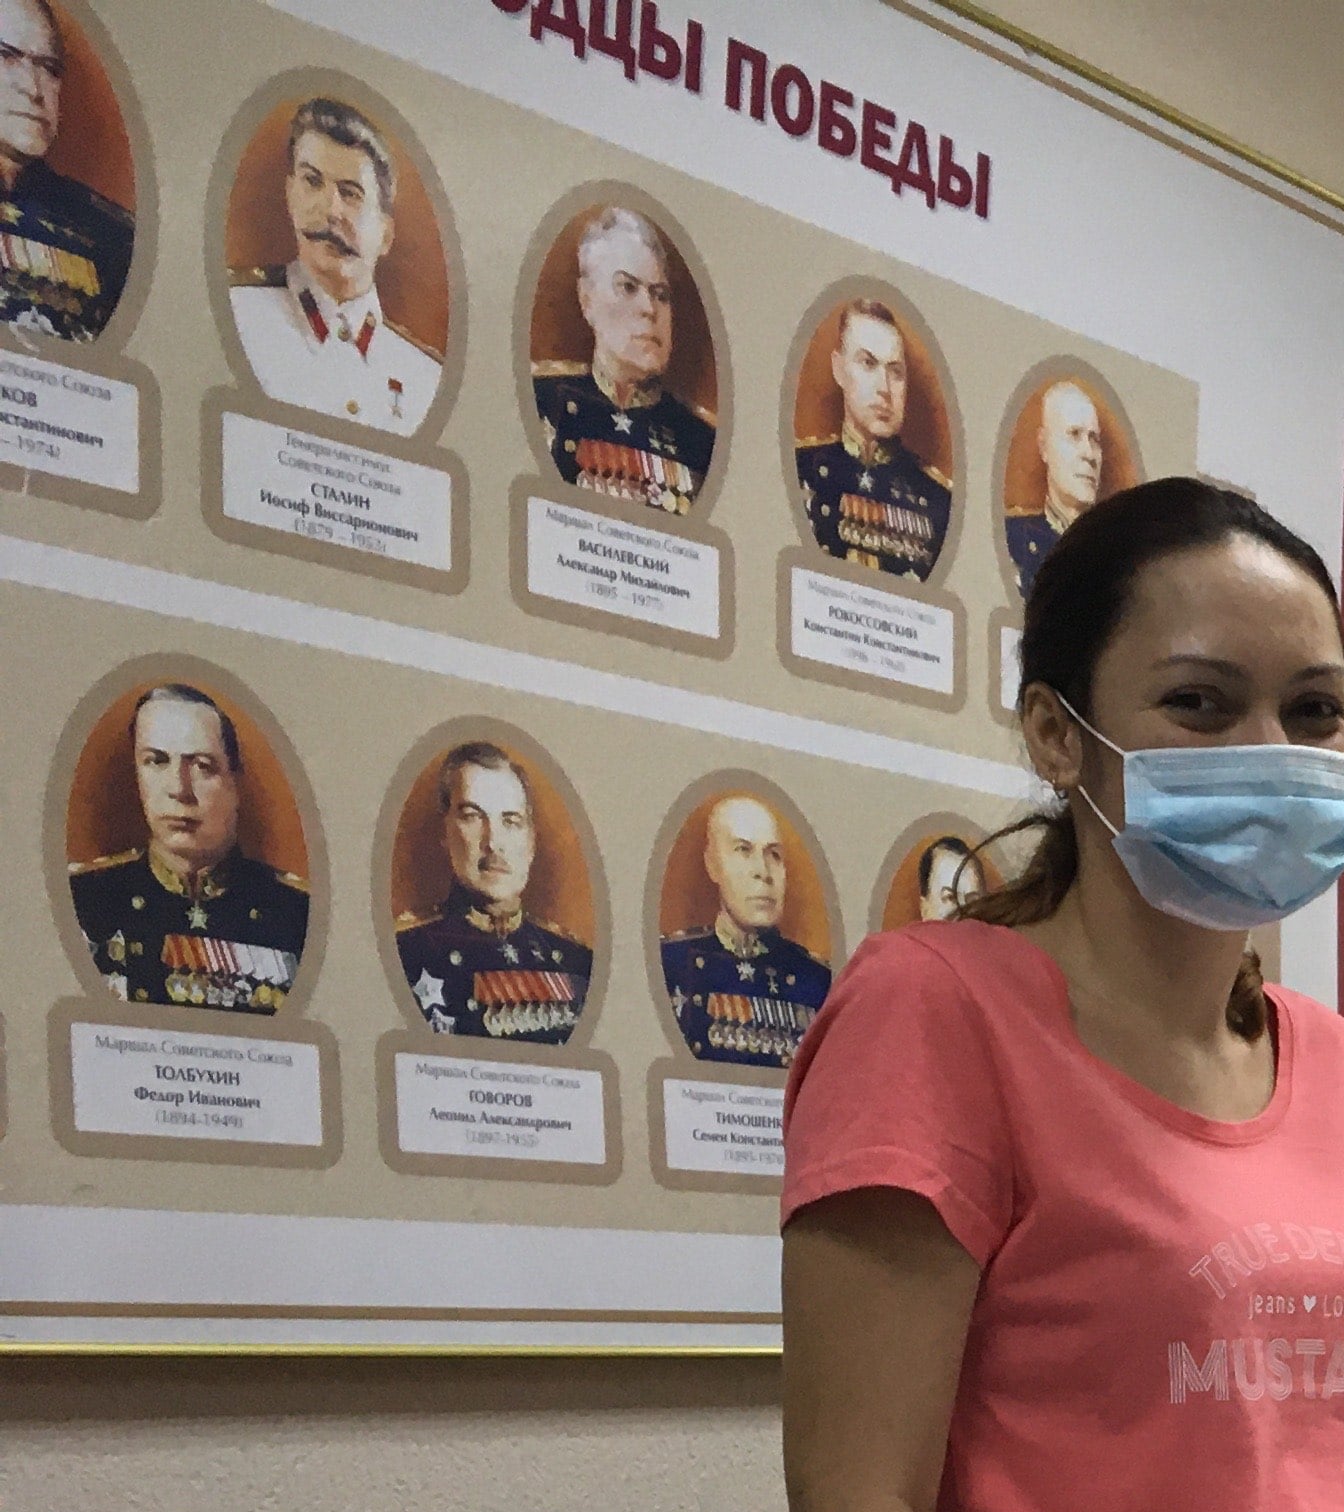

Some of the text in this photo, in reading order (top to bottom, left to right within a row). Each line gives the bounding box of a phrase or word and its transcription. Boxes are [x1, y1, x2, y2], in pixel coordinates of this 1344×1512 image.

[724, 36, 992, 220] ПОБЕДЫ
[310, 482, 371, 511] СТАЛИН
[260, 488, 419, 542] Иосиф Виссарионович
[578, 538, 671, 575] ВАСИЛЕВСКИЙ
[556, 554, 691, 599] Александр Михайлович
[155, 1064, 240, 1086] ТОЛБУХИН
[134, 1086, 261, 1109] Федор Иванович
[469, 1089, 532, 1108] ГОВОРОВ
[1189, 1222, 1290, 1299] TRUE
[1249, 1294, 1296, 1319] jeans
